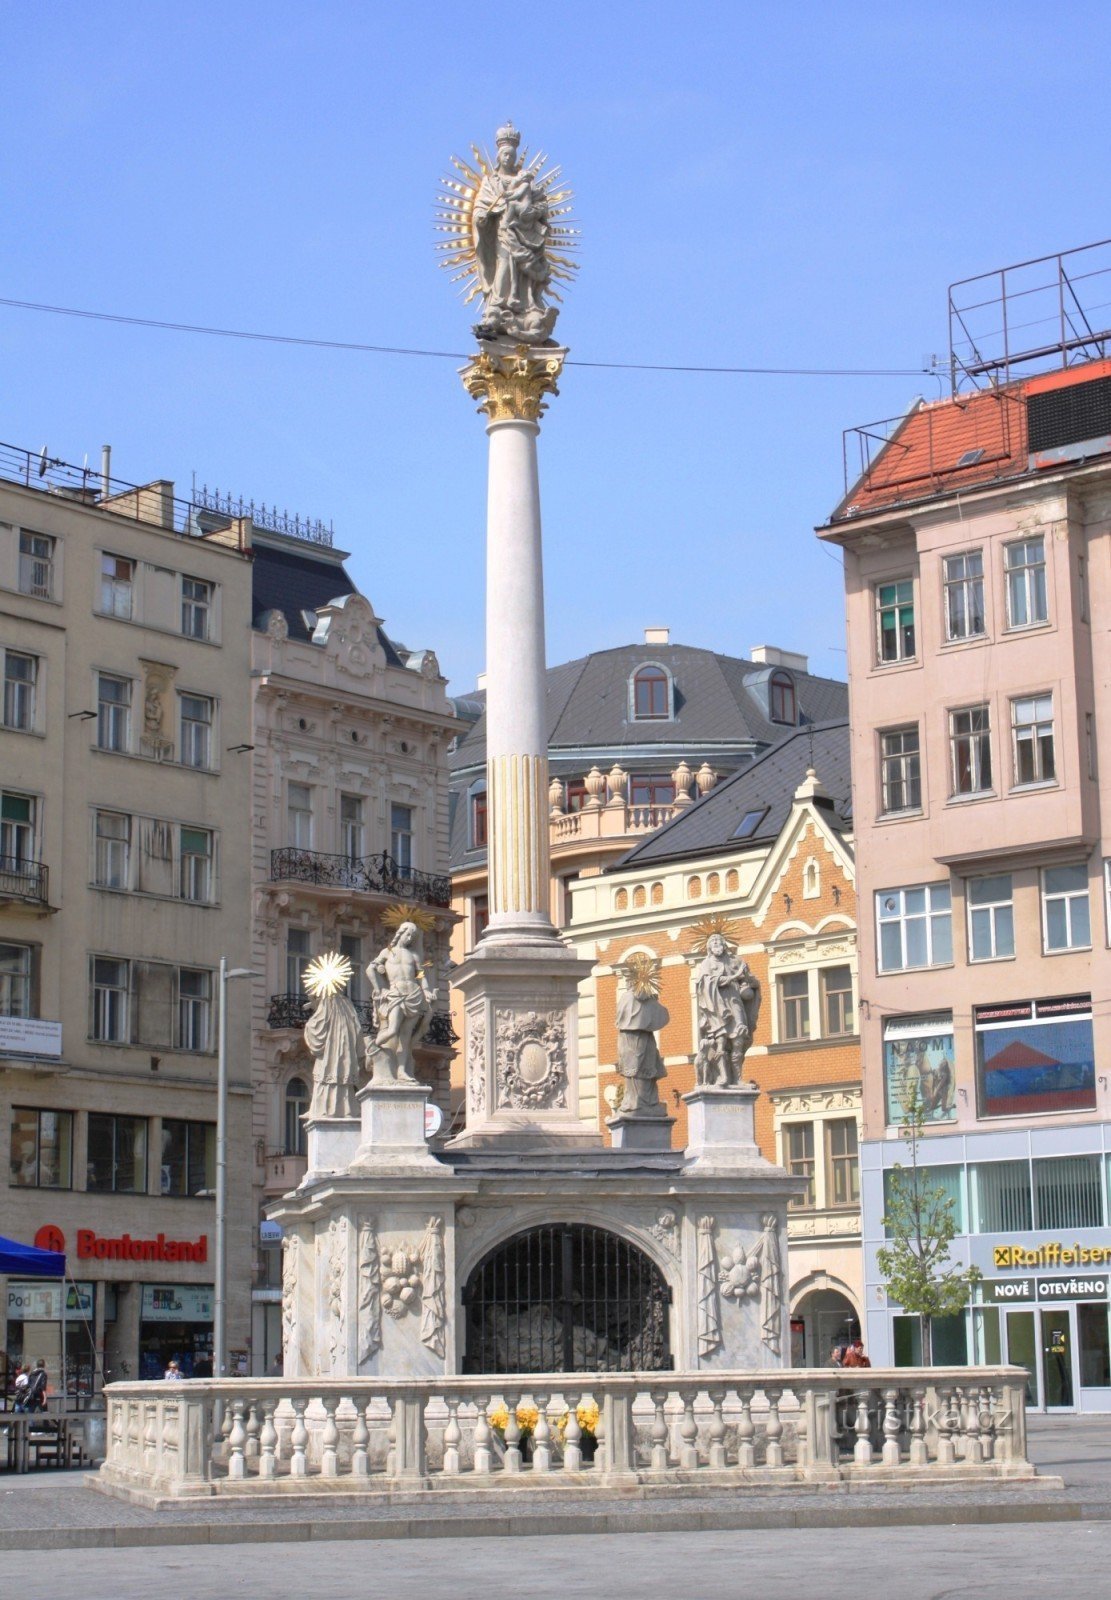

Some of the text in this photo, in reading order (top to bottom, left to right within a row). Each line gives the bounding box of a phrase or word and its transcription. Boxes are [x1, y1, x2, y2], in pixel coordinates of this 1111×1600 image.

[891, 1037, 952, 1055] NAOMI
[77, 1229, 208, 1263] Bontonland
[994, 1279, 1105, 1297] NOVĚ OTEVŘENO
